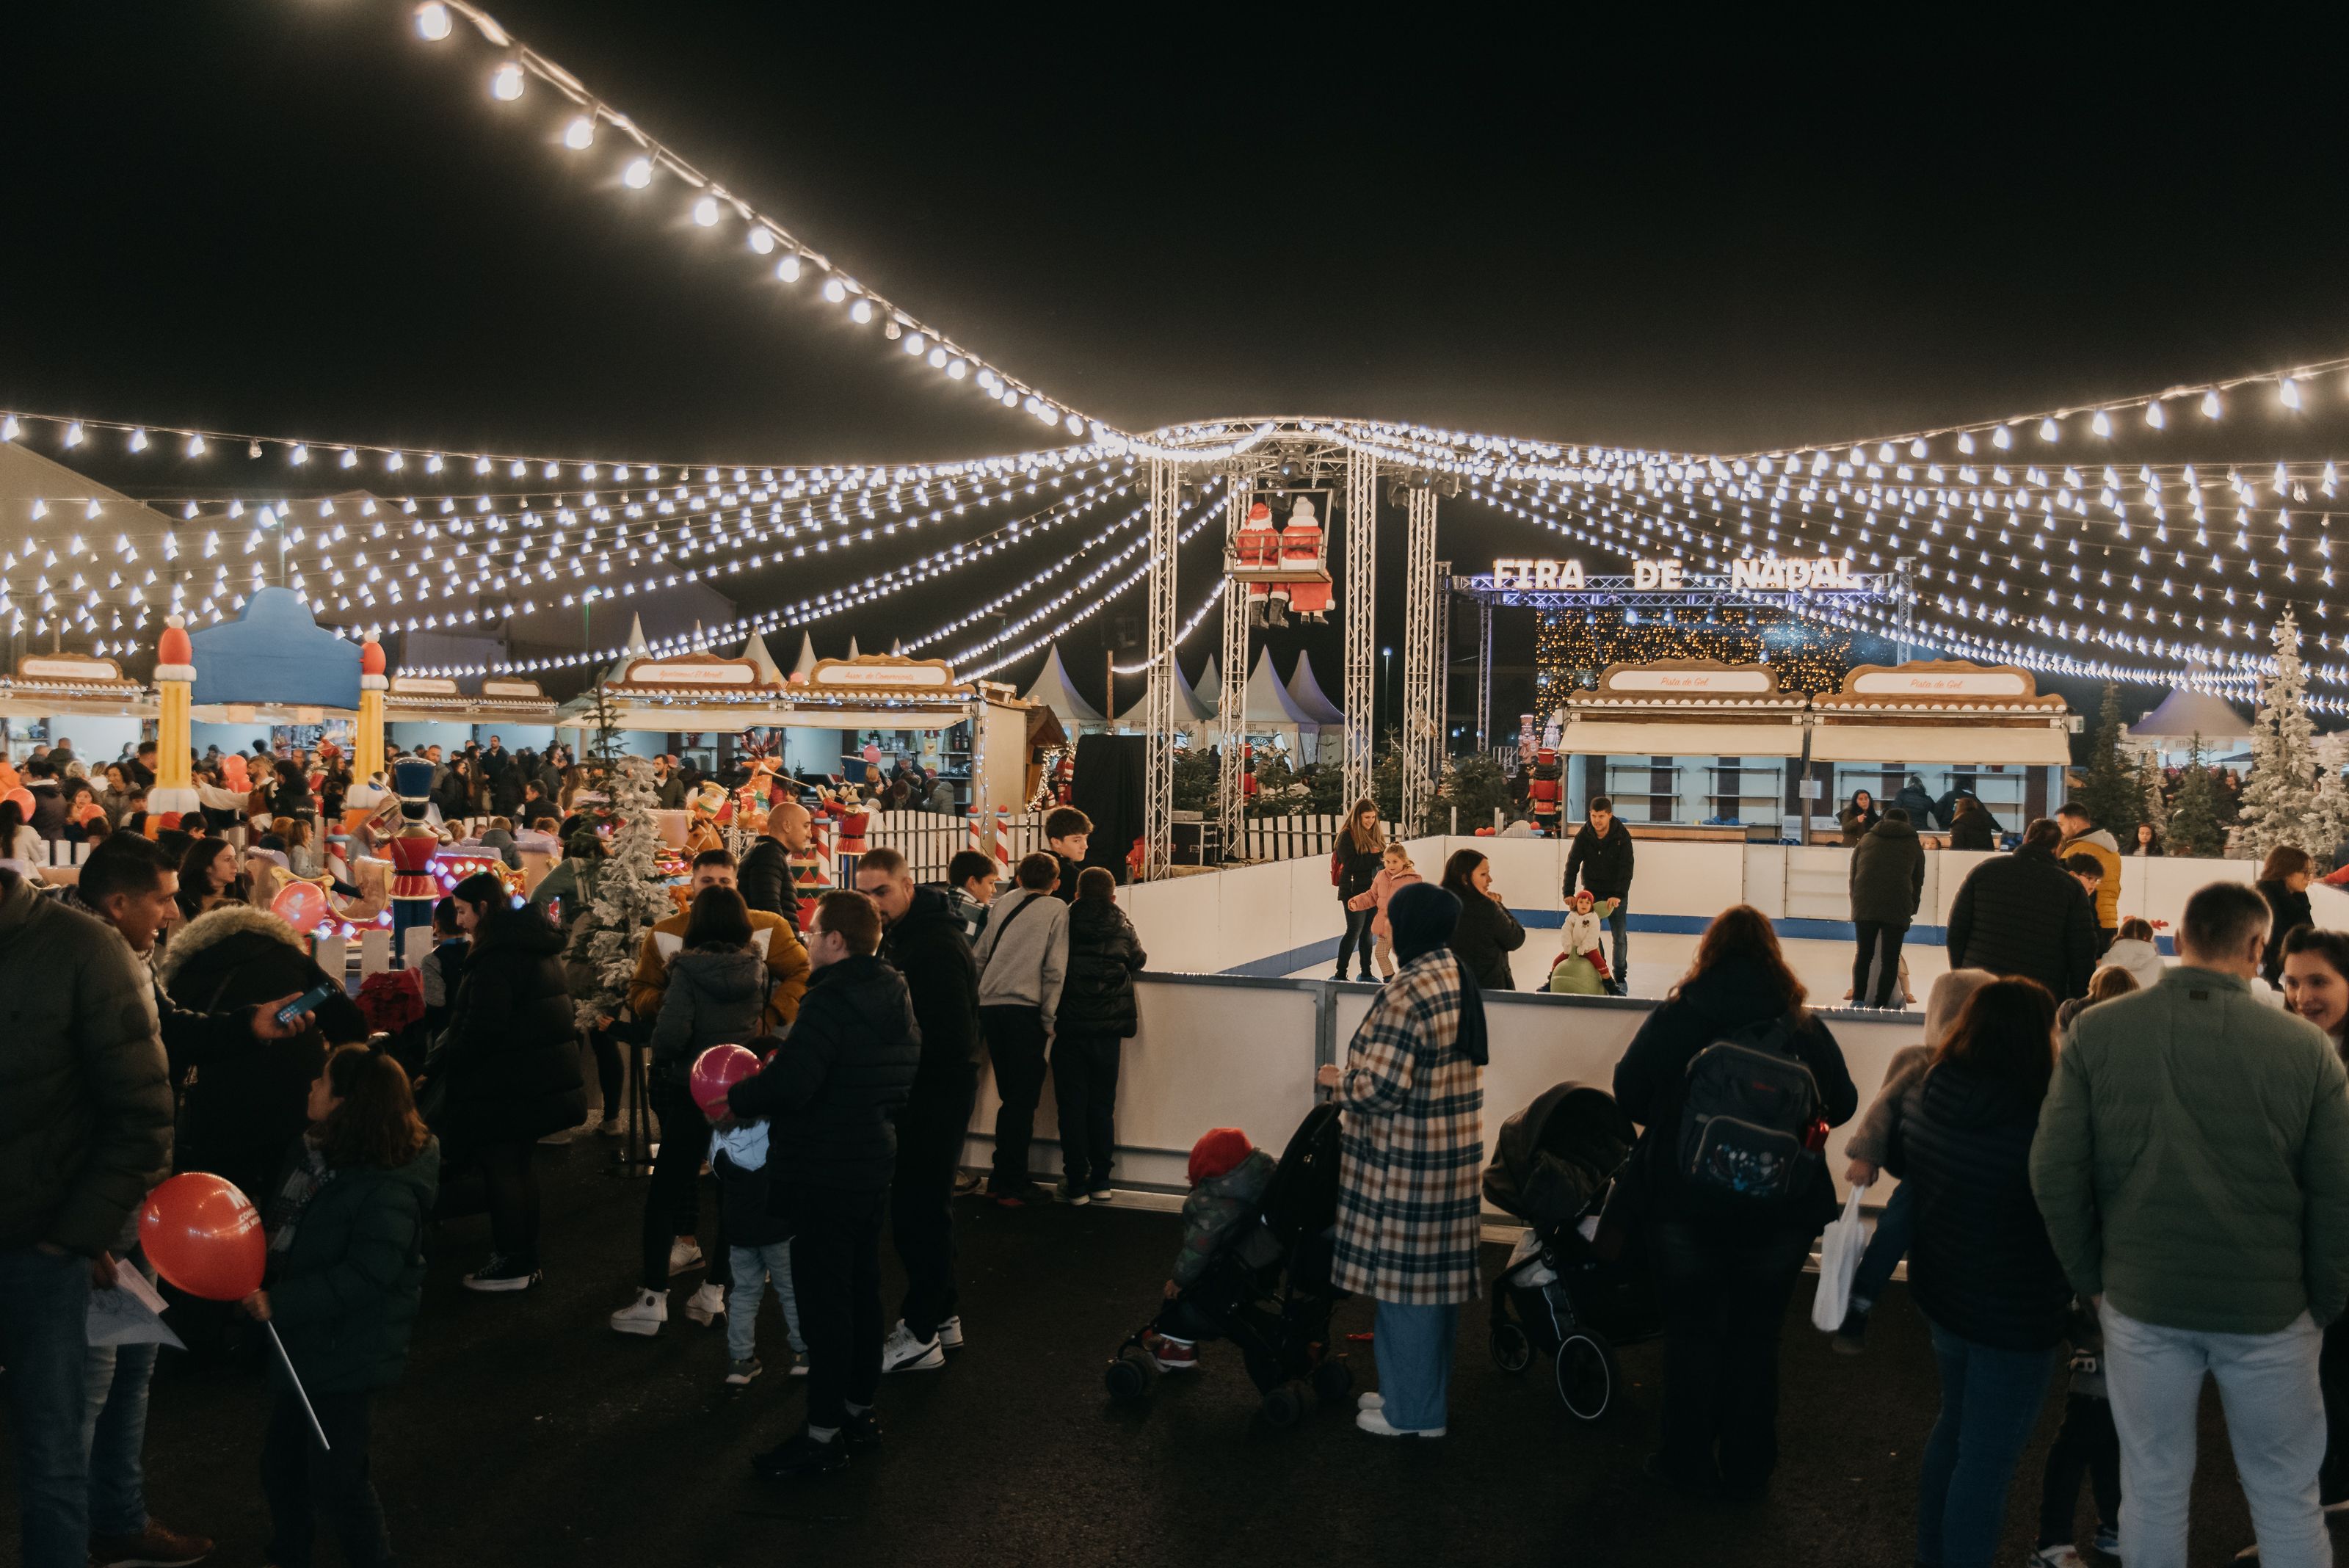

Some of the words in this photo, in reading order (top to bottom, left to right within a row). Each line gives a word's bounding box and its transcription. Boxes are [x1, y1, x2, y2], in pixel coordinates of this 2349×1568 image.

[1493, 559, 1585, 589] FIRA
[1633, 559, 1682, 590] DE
[1732, 558, 1862, 589] NADAL
[1660, 677, 1680, 686] Pista
[1682, 677, 1692, 686] de
[1693, 677, 1710, 686] Gel
[1909, 678, 1932, 688] Pista
[1933, 680, 1945, 688] de
[1946, 680, 1963, 689] Gel
